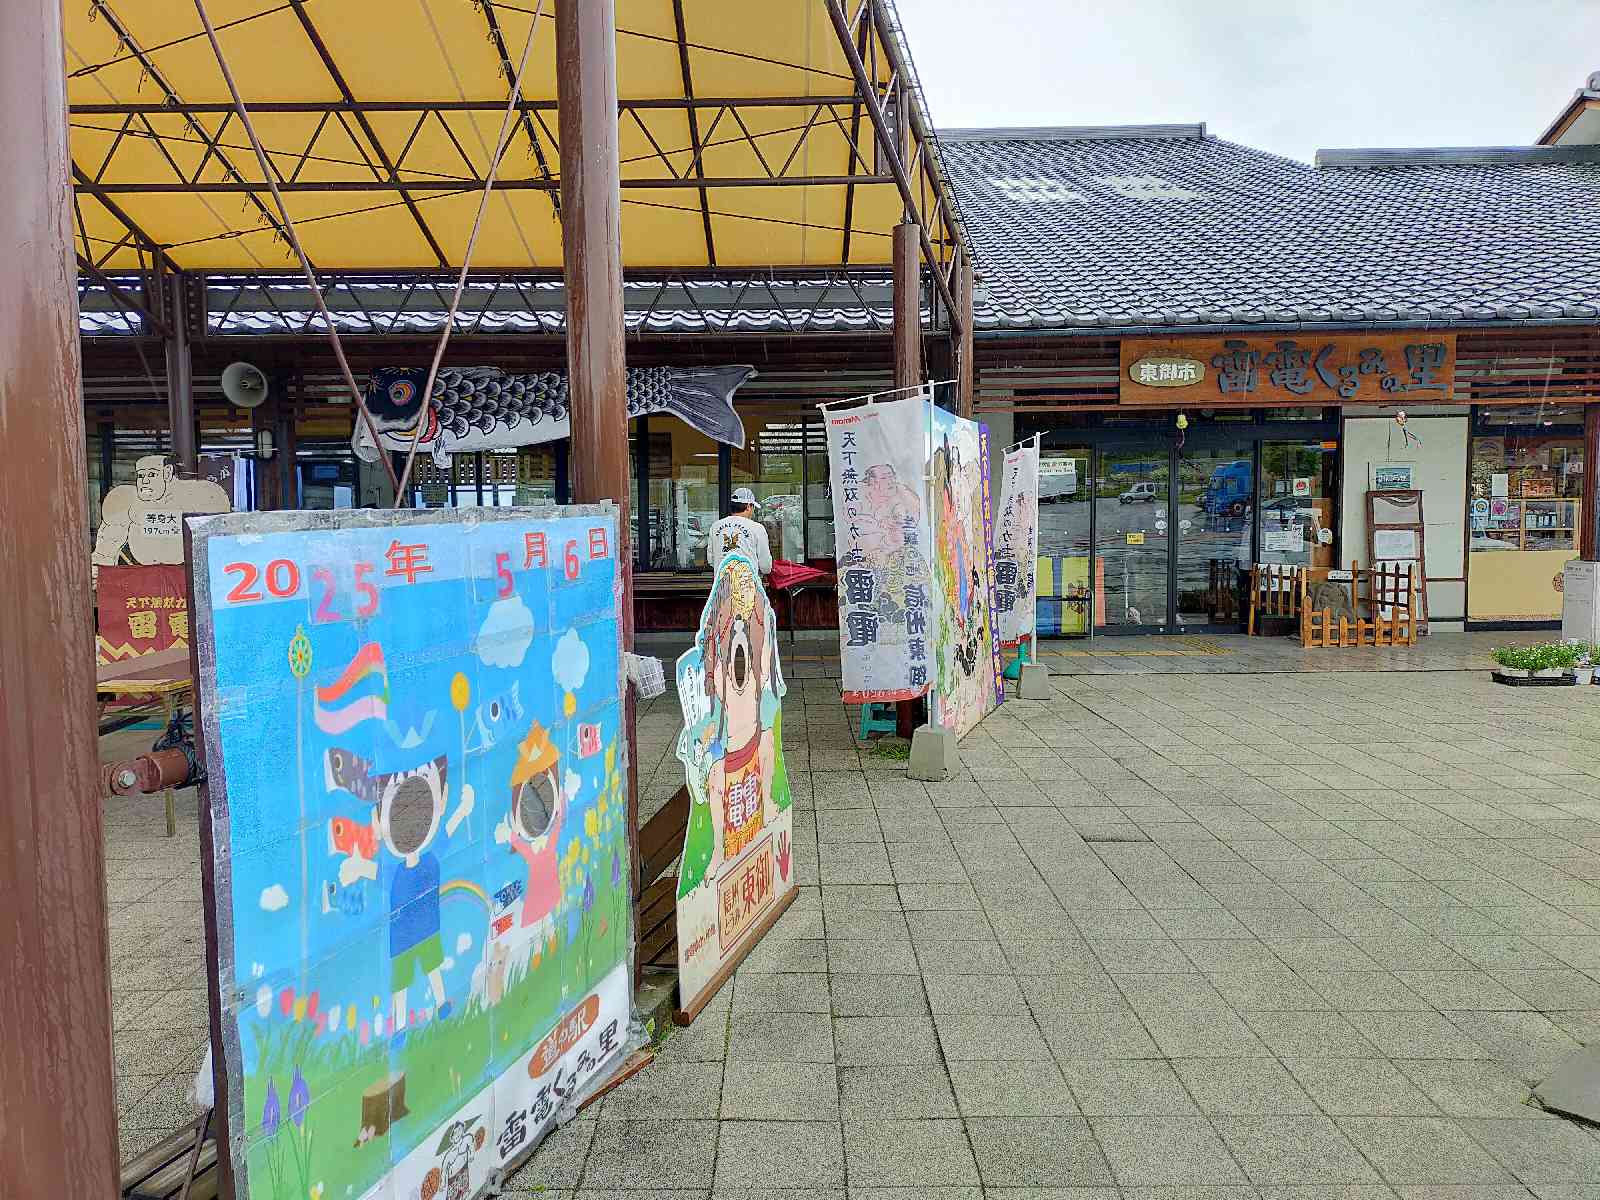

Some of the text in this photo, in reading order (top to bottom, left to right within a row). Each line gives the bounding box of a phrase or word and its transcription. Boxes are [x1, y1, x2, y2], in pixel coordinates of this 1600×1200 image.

[1139, 362, 1197, 382] 東御市
[1211, 340, 1450, 398] 雷電くるみの里
[146, 513, 177, 524] 等身大
